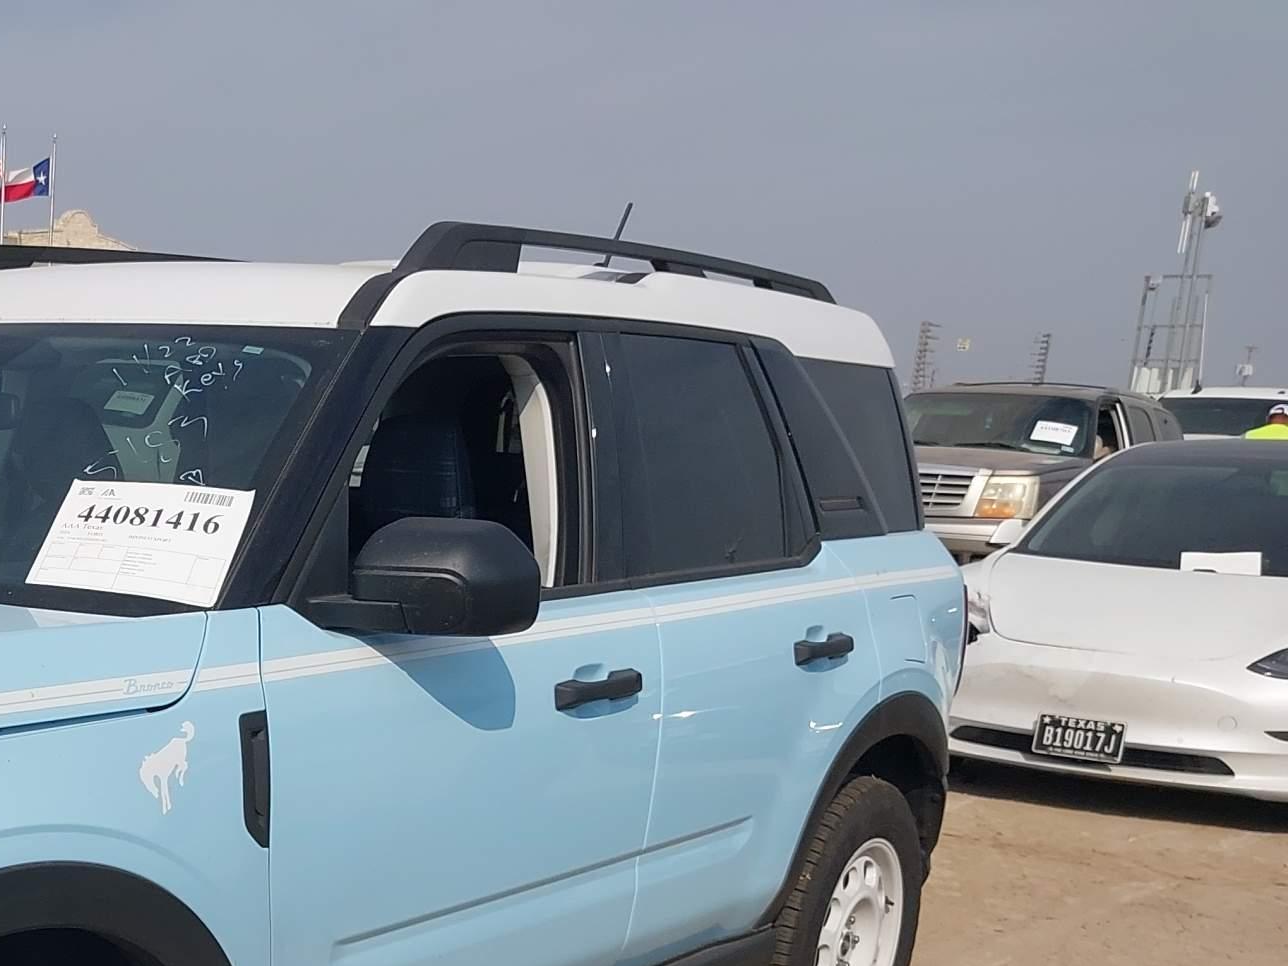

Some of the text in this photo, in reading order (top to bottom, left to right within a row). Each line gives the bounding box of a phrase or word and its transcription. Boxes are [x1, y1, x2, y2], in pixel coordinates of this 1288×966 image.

[77, 504, 224, 535] 44081416
[122, 678, 174, 695] Bronco
[1060, 717, 1106, 732] TEXAS
[1042, 725, 1117, 754] B19017J
